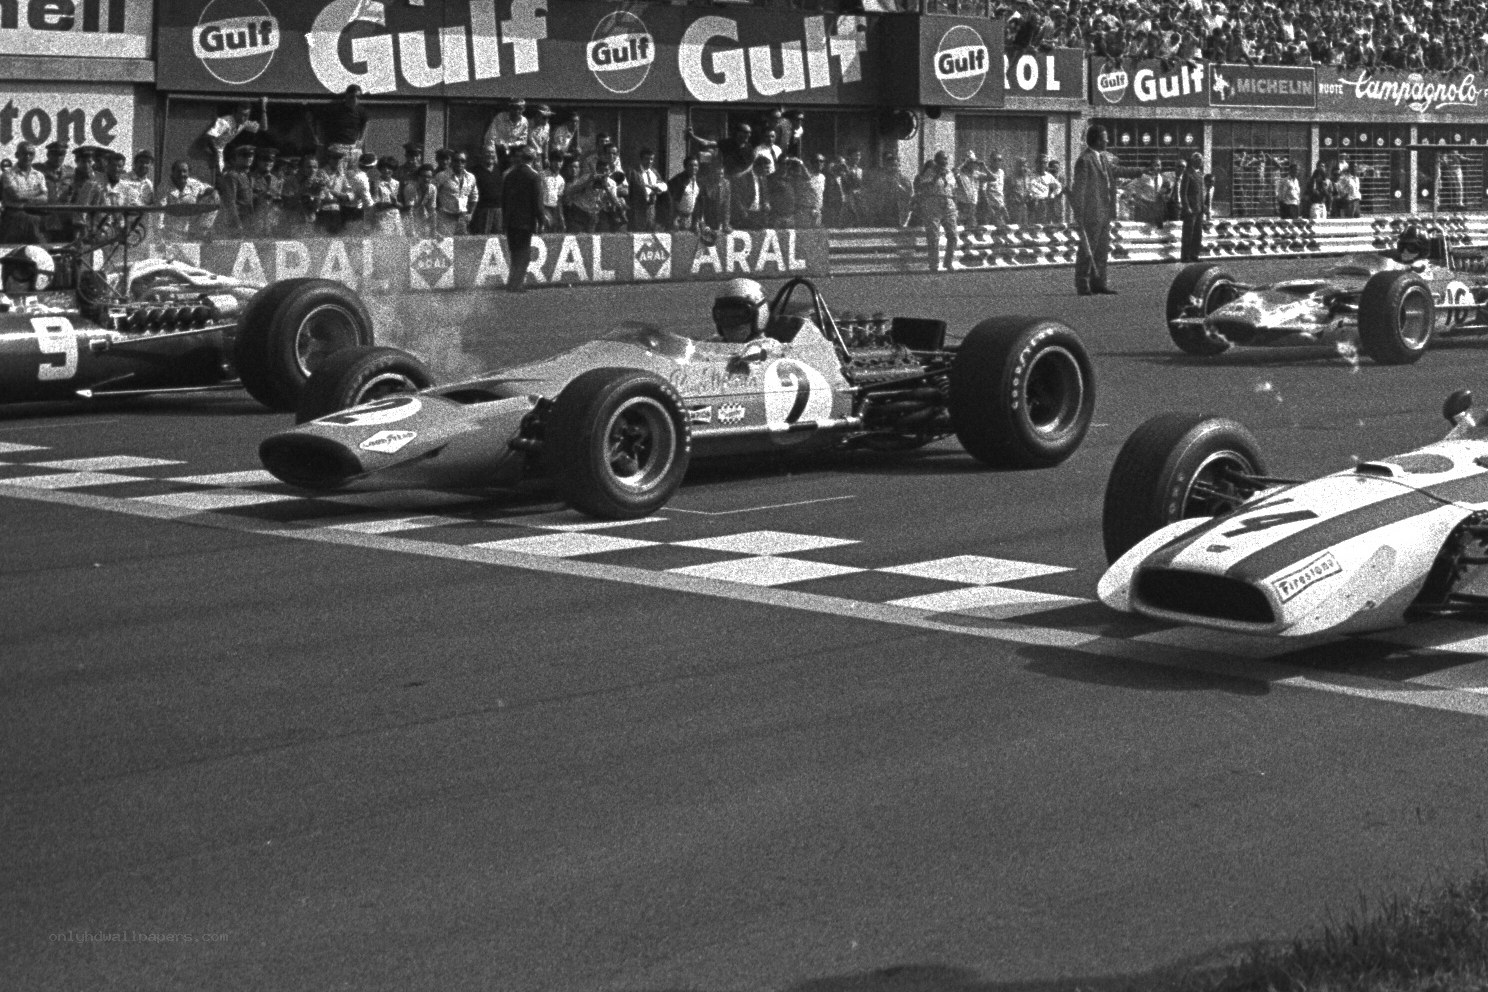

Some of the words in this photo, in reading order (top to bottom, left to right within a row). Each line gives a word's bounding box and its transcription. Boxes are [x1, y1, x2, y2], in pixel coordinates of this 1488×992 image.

[199, 21, 272, 53] Gulf
[590, 37, 650, 66] Gulf
[678, 15, 868, 101] Gulf
[938, 50, 987, 75] Gulf
[1100, 74, 1126, 89] Gulf
[1134, 63, 1205, 102] Gulf
[1237, 78, 1313, 95] MICHELIN
[1318, 82, 1344, 95] RUOTE
[1338, 70, 1482, 113] Campagnolo
[473, 234, 615, 286] ARAL
[639, 248, 666, 261] ARAL
[691, 228, 806, 275] ARAL
[31, 316, 78, 381] 9
[1278, 558, 1335, 596] Firestone
